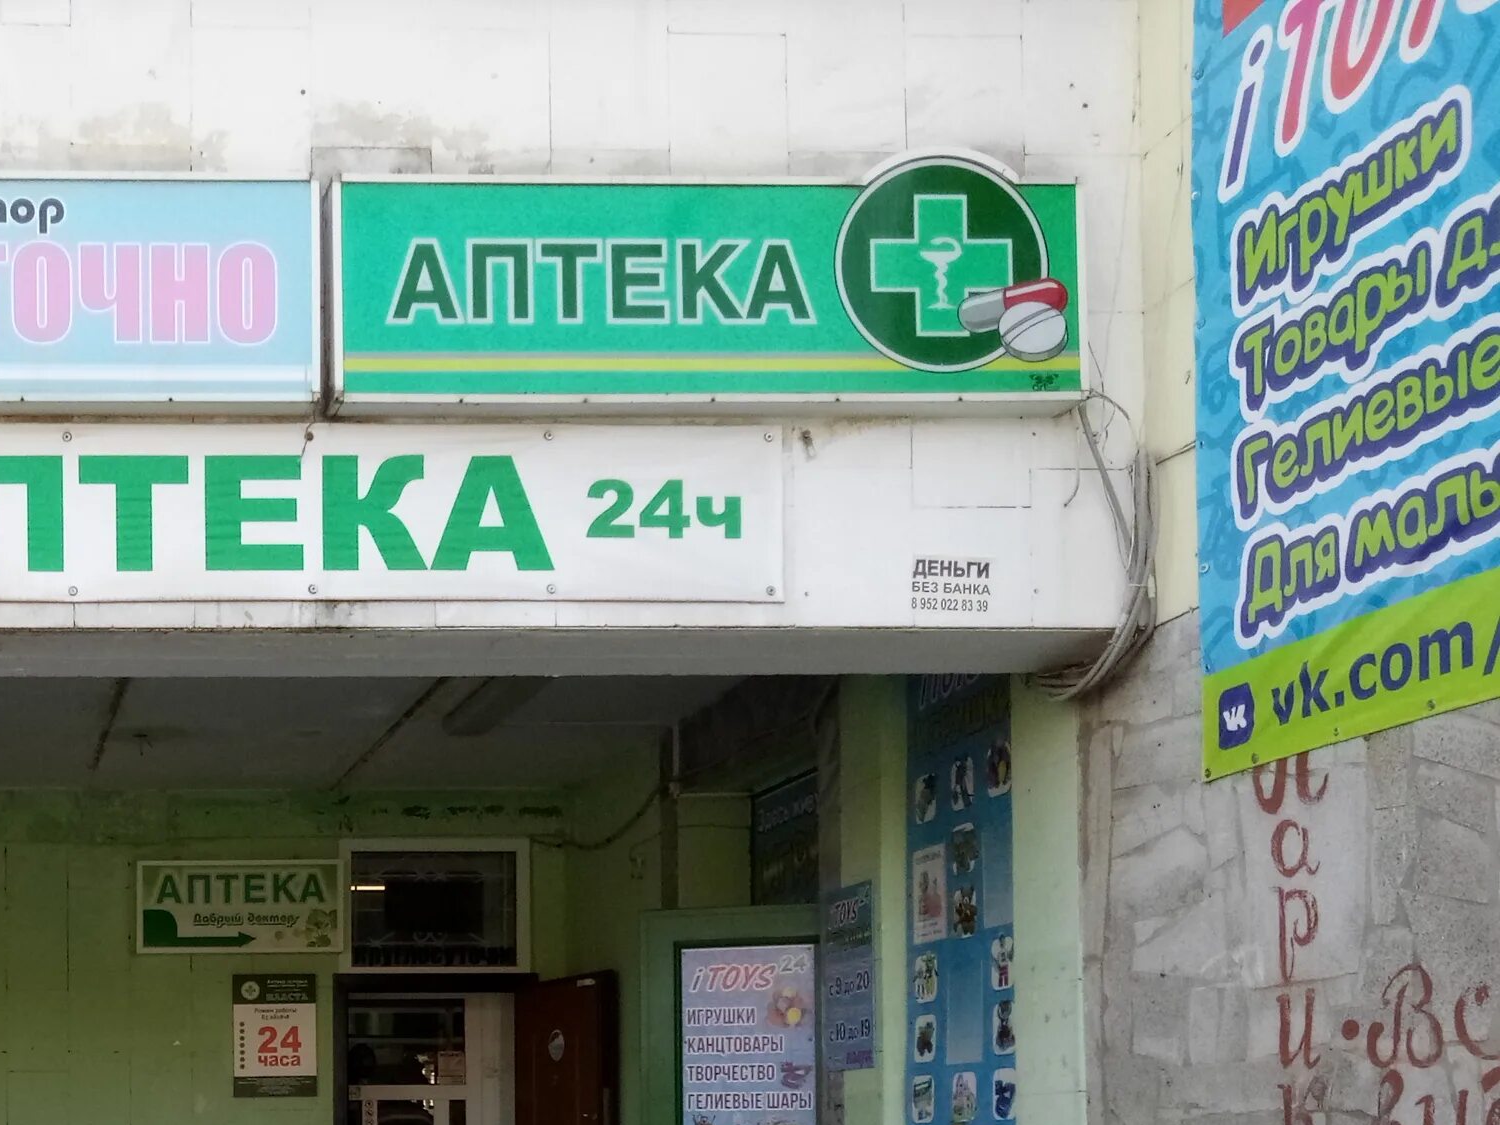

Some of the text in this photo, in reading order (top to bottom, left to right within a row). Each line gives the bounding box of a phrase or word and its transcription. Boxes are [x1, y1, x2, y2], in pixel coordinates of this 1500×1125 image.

[1240, 102, 1460, 294] Игрушки
[390, 237, 815, 324] АПТЕКА
[1241, 246, 1428, 398] Товары
[585, 478, 743, 540] 24ч
[912, 559, 991, 579] ДЕНЬГИ
[1246, 532, 1338, 625] Для
[911, 581, 991, 595] БЕЗ БАНКА
[911, 597, 988, 612] 8 952 022 83 39
[156, 872, 326, 904] АПТЕКА
[193, 911, 244, 928] Добрый
[856, 971, 870, 991] 20
[686, 1007, 756, 1026] ИГРУШКИ
[257, 1025, 302, 1054] 24
[686, 1036, 784, 1055] КАНЦТОВАРЫ
[257, 1054, 301, 1067] часа
[686, 1064, 776, 1082] ТВОРЧЕСТВО
[686, 1092, 812, 1110] ГЕЛИЕВЫЕ ШАРЫ
